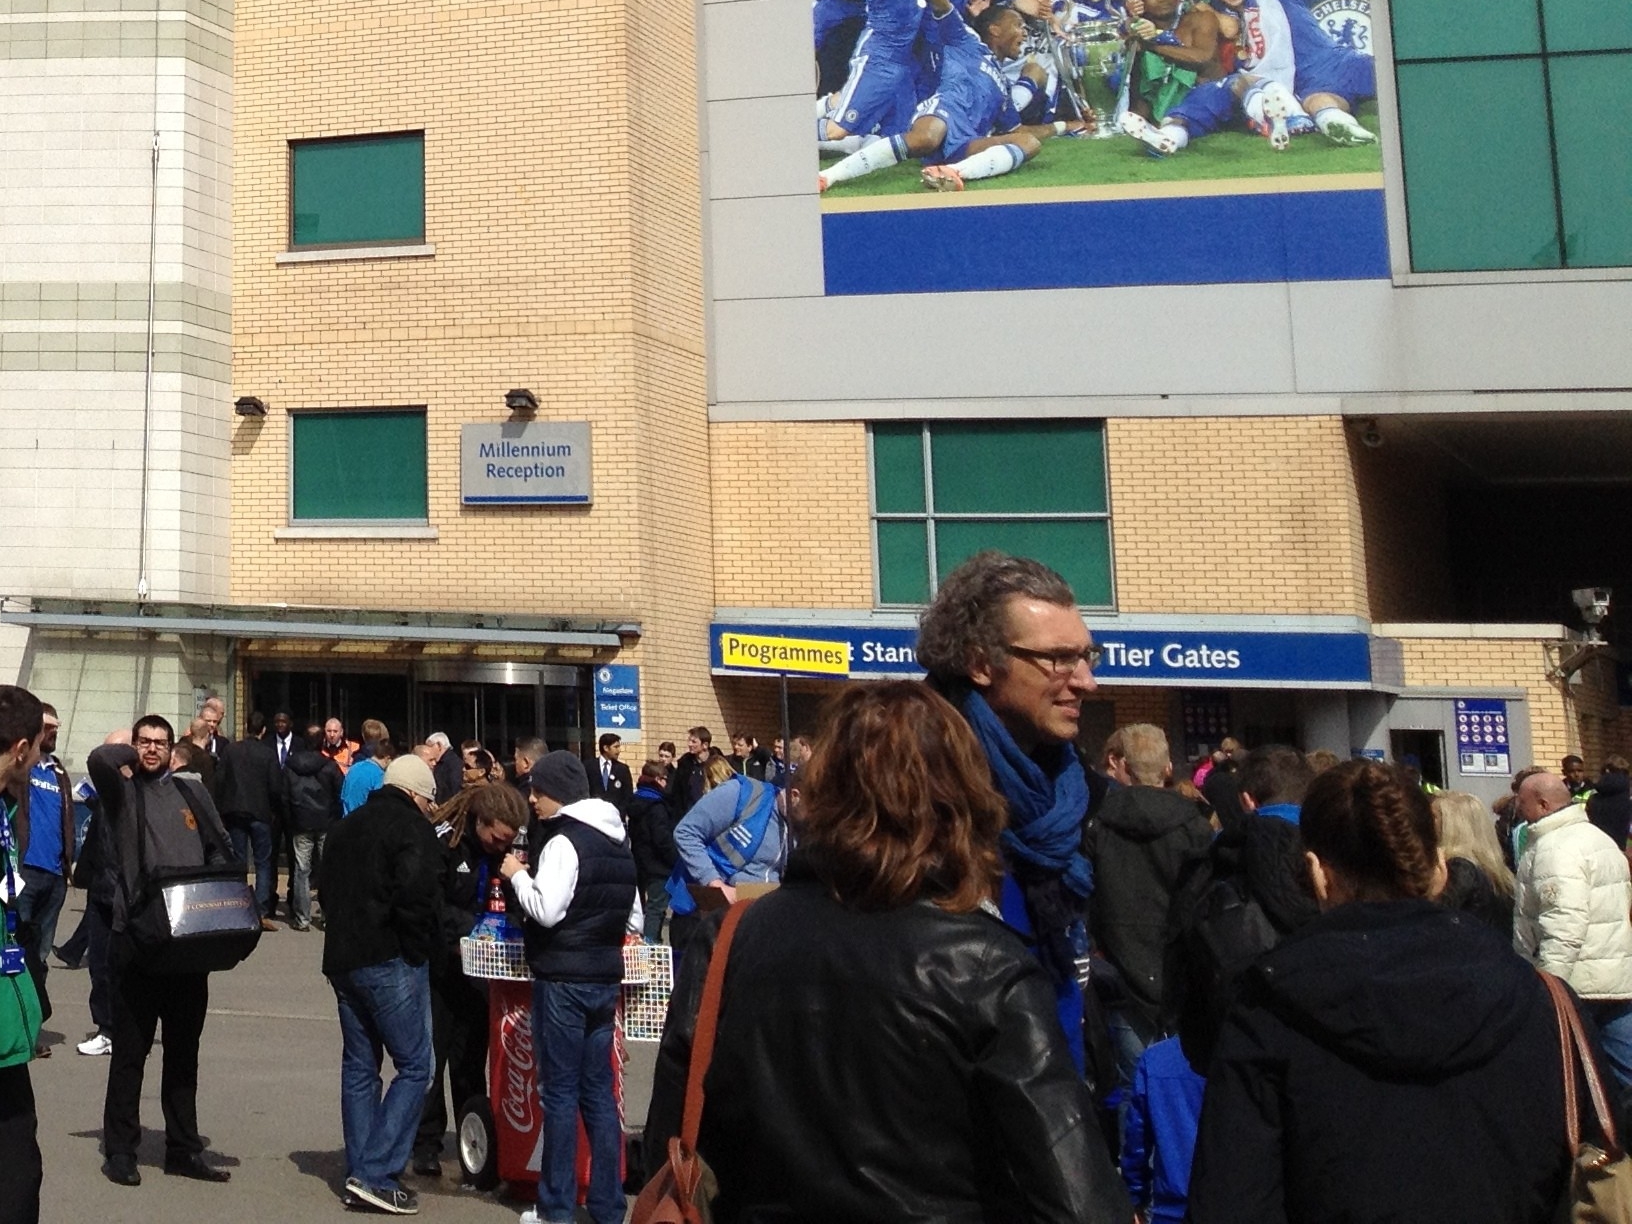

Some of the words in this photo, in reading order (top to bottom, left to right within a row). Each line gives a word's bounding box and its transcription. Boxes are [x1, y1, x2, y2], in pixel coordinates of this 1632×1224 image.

[479, 441, 572, 458] Millennium
[486, 462, 566, 482] Reception
[728, 637, 844, 665] Programmes
[862, 641, 918, 663] Stan
[1103, 642, 1154, 667] Tier
[1163, 643, 1241, 669] Gates
[600, 703, 617, 711] Ticket
[618, 704, 637, 712] Office
